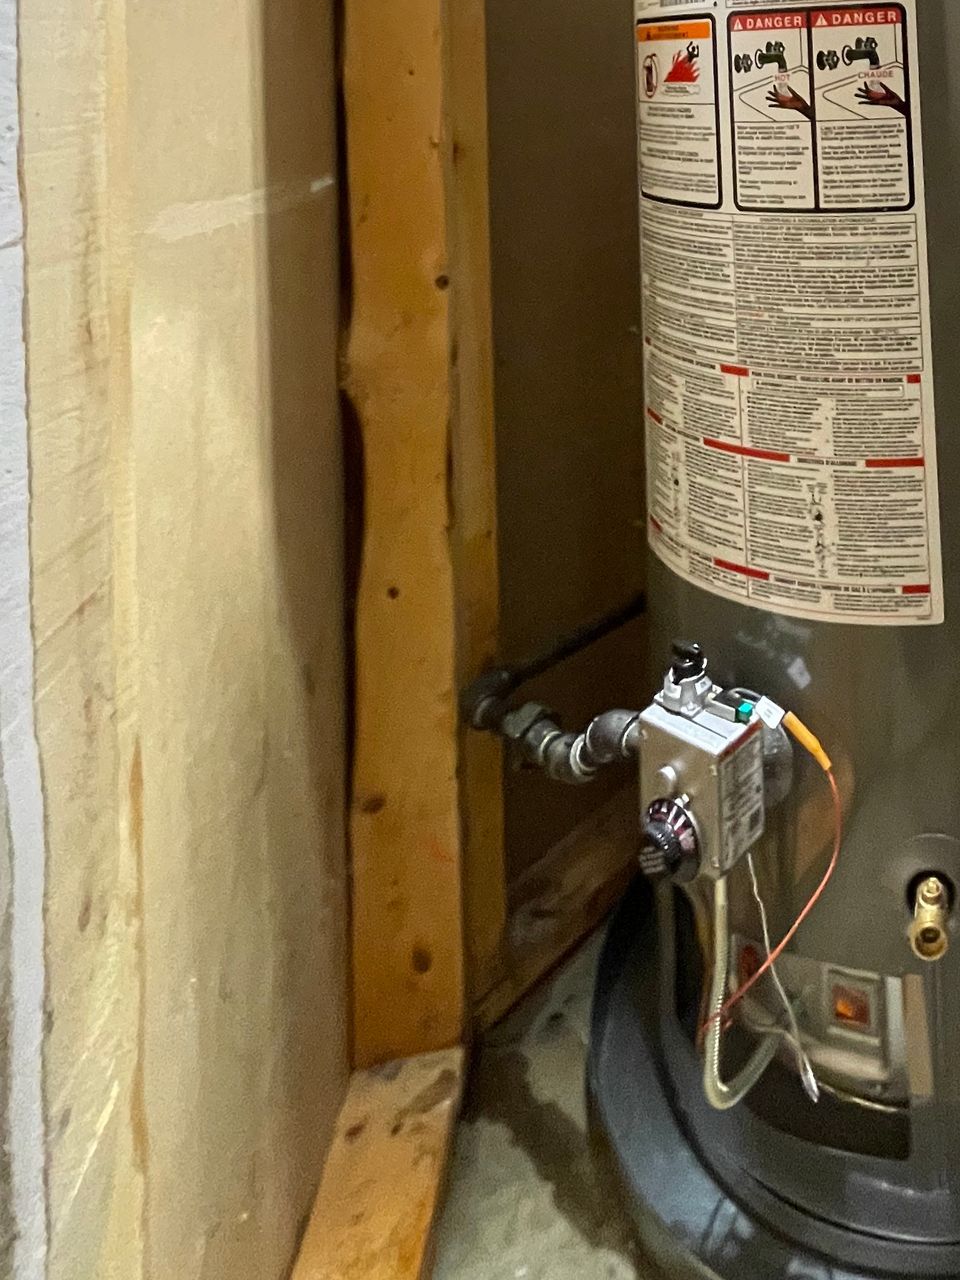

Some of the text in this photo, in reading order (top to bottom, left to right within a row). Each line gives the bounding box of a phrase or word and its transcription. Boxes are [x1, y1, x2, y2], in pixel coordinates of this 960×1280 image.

[746, 16, 802, 29] DANGER
[832, 11, 897, 24] DANGER
[858, 70, 894, 79] CHAUDE
